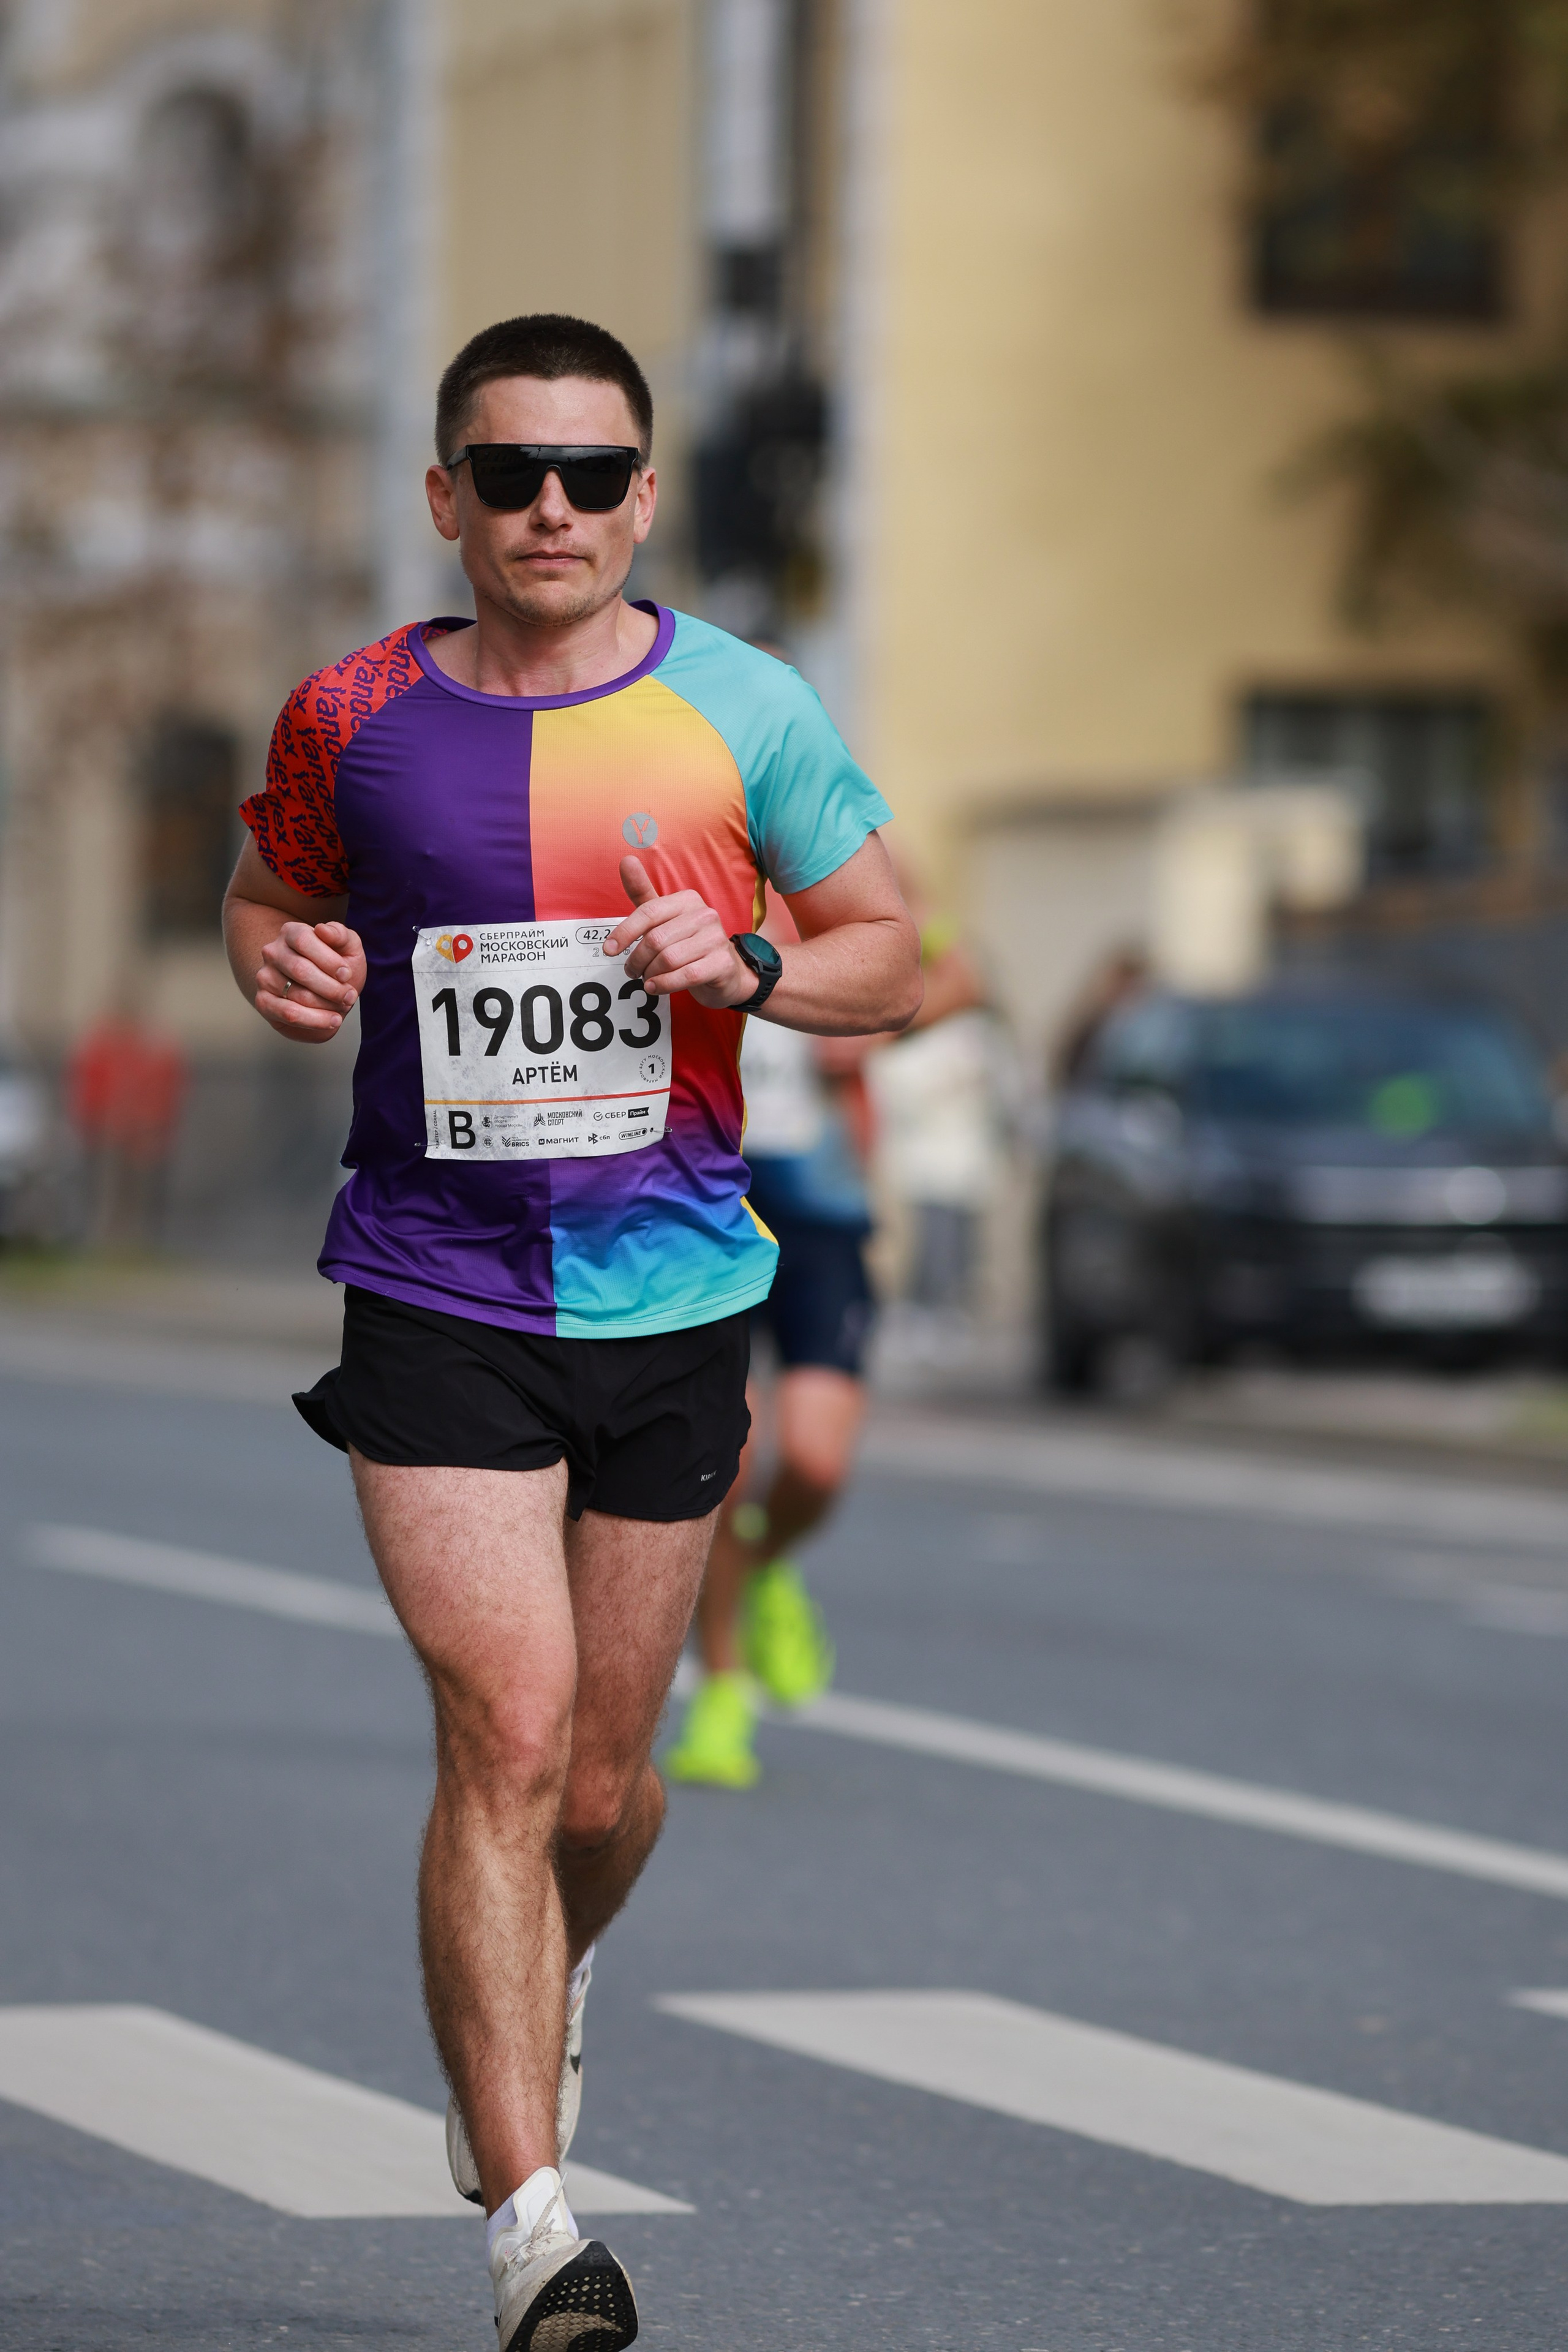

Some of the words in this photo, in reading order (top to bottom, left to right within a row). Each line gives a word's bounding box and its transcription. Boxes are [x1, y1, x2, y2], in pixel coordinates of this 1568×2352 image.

[480, 929, 545, 940] СБЕРПРАЙМ
[480, 937, 568, 952] МОСКОВСКИЙ
[481, 951, 546, 963] МАРАФОН
[432, 979, 662, 1057] 19083
[512, 1061, 578, 1085] АРТЁМ
[648, 1063, 655, 1074] 1
[547, 1109, 582, 1118] МОСКОВСКИЙ
[448, 1110, 476, 1149] B
